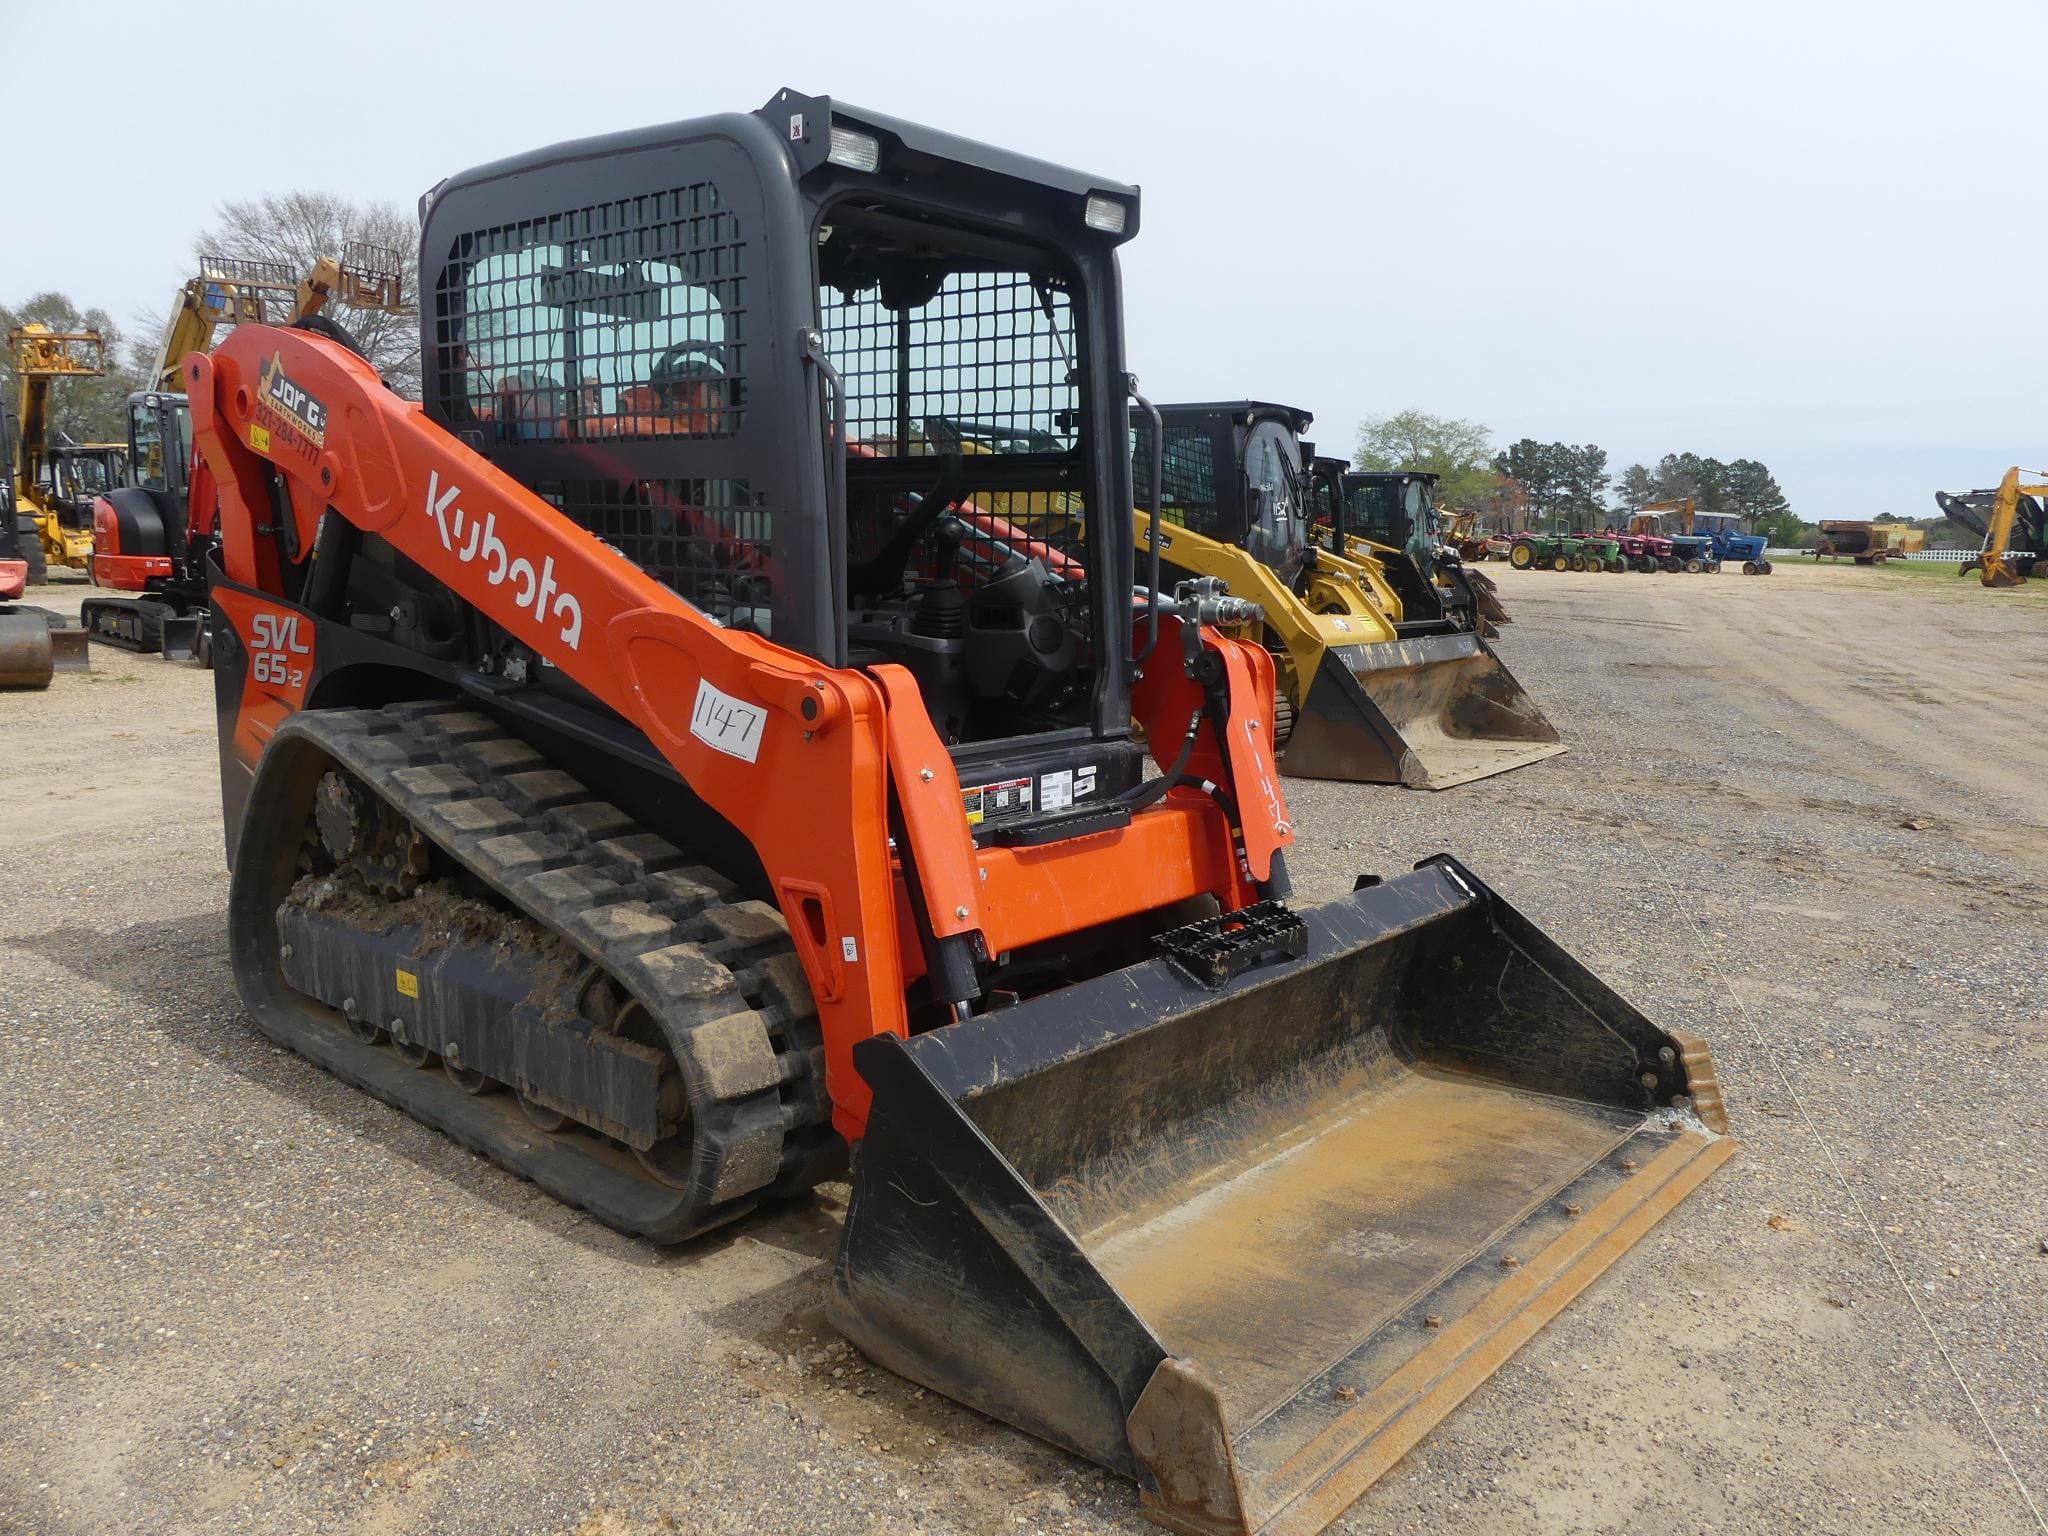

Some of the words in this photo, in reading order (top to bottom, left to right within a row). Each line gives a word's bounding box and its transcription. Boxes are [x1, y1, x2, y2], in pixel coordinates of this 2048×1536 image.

[271, 400, 317, 440] EARTHWORKS
[307, 401, 320, 427] G
[425, 470, 582, 650] Kubota
[250, 614, 310, 654] SVL
[696, 691, 756, 742] 1147
